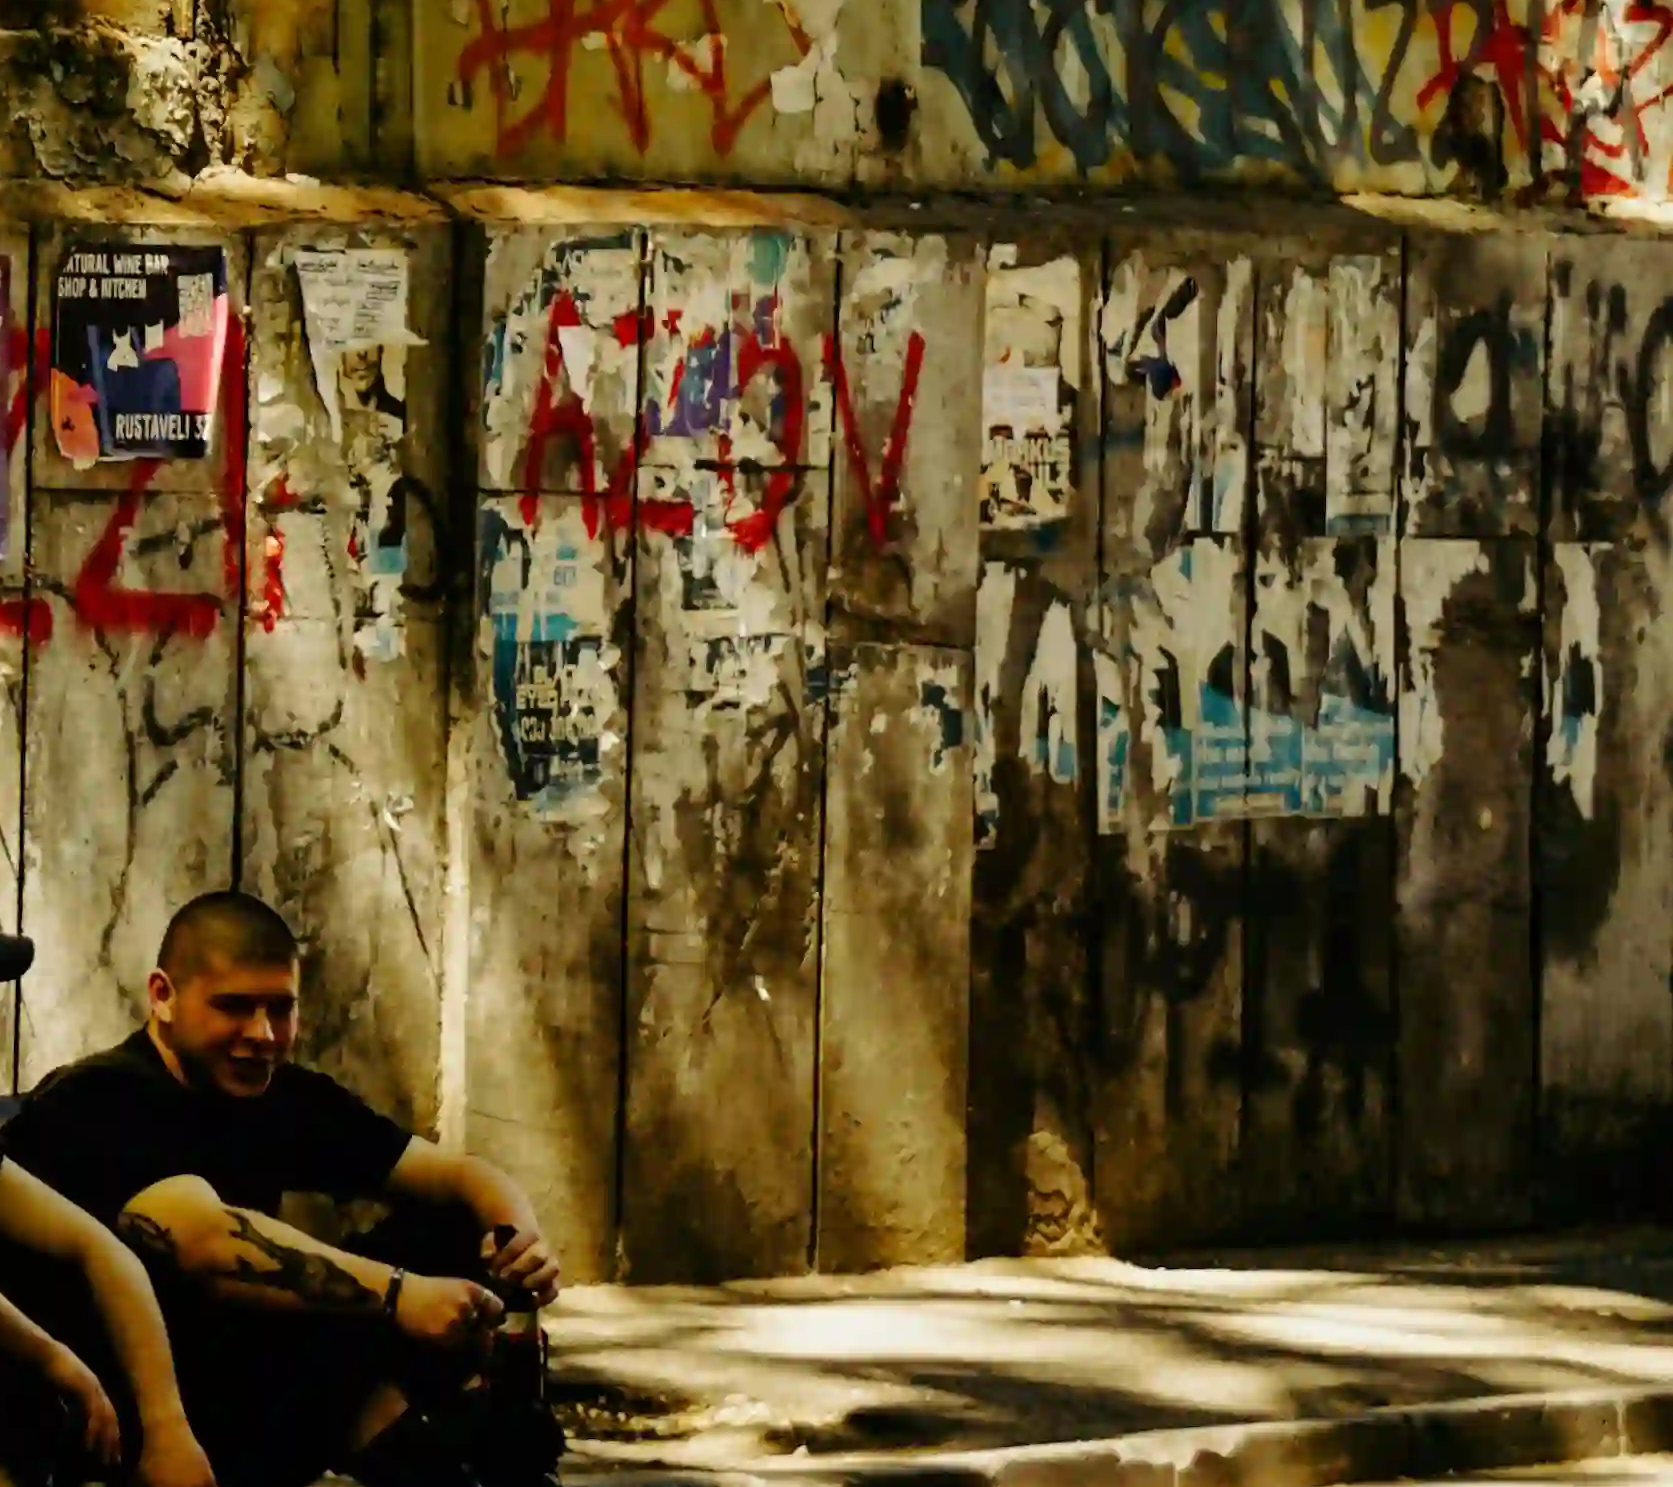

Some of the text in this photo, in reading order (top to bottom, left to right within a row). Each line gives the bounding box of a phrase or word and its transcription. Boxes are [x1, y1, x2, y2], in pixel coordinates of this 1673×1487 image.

[63, 253, 171, 276] ATURAL WINE BAR
[58, 276, 148, 300] SHOP & KITCHEN
[114, 413, 191, 441] RUSTAVELI
